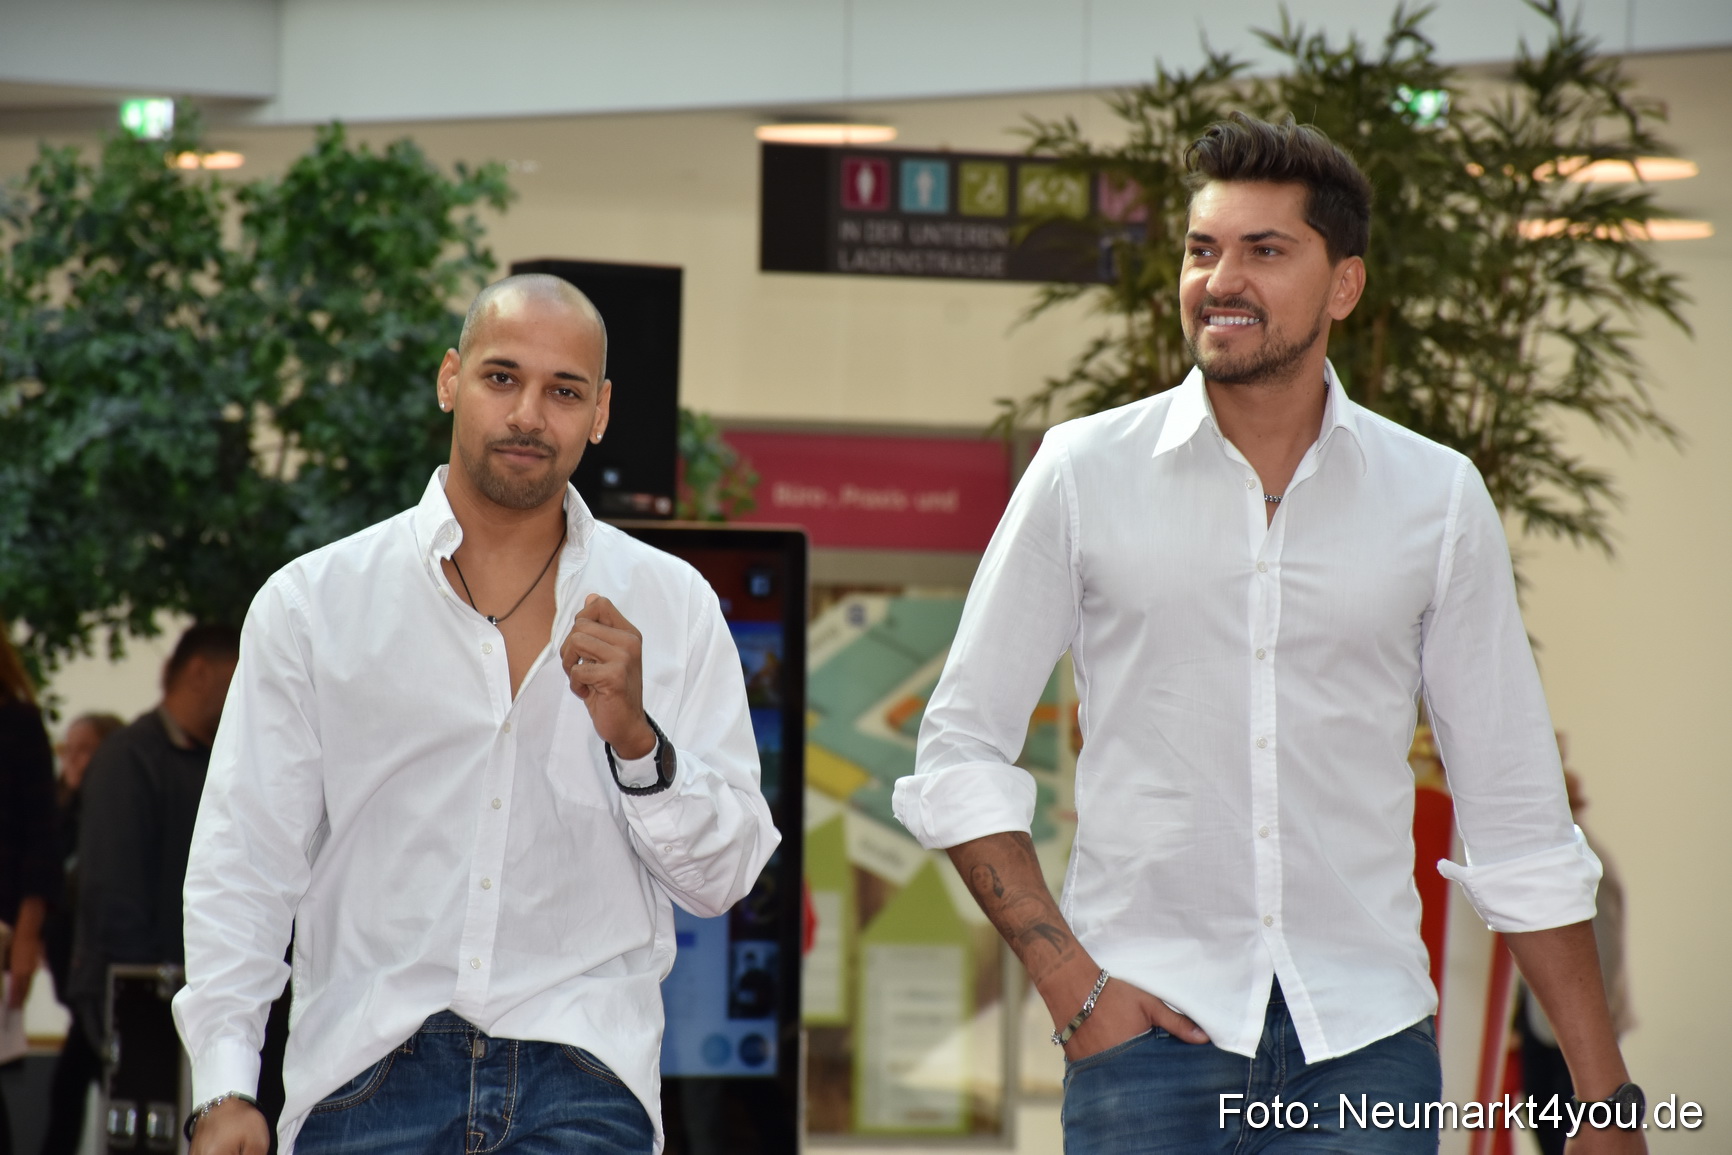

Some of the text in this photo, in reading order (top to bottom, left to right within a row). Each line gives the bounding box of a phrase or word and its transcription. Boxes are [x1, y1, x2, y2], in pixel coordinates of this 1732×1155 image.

[839, 220, 860, 242] IN
[865, 220, 904, 243] DER
[838, 249, 1004, 275] LADENSTRASSE
[917, 488, 957, 512] und
